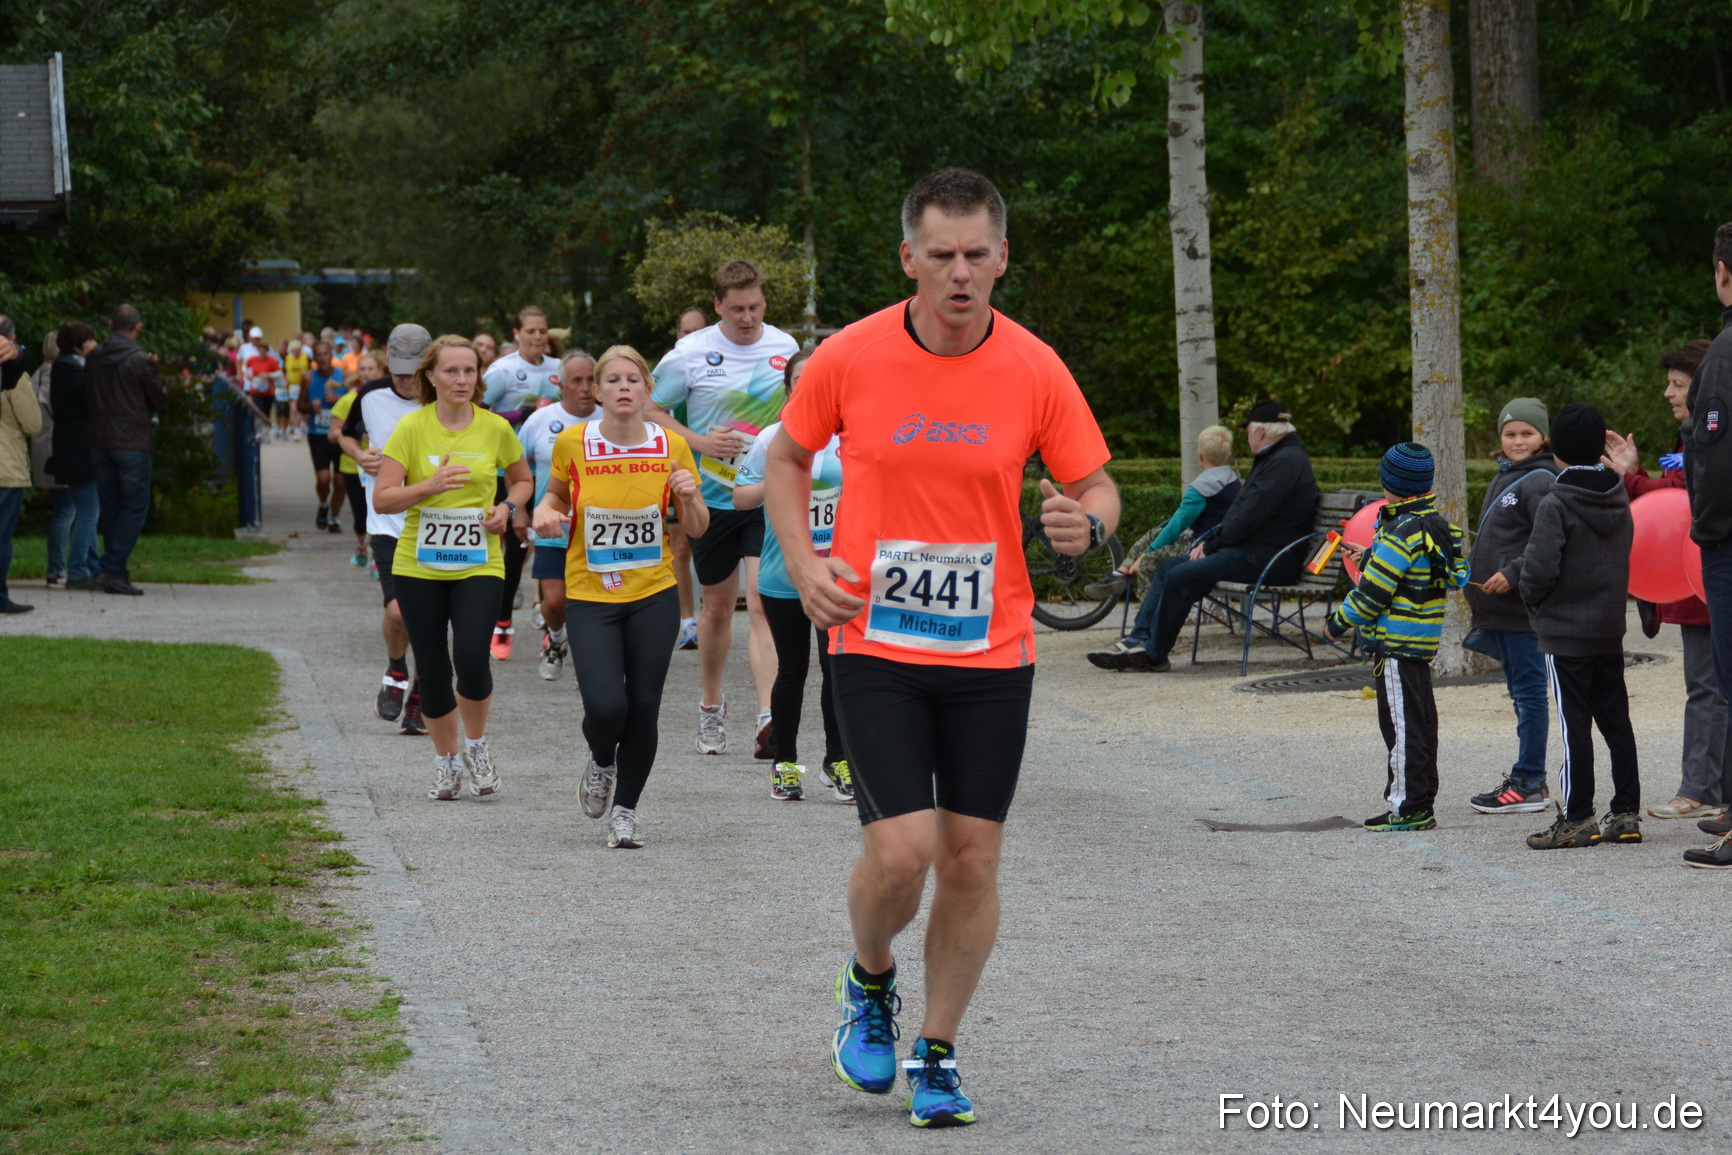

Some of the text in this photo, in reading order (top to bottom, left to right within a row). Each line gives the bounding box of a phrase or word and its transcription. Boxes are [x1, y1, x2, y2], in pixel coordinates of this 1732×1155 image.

[925, 422, 989, 444] asics
[585, 461, 669, 476] MAX BÖGL
[719, 467, 735, 481] Jörg
[421, 512, 441, 520] PARTL
[586, 512, 611, 520] PARTL
[424, 522, 481, 547] 2725
[592, 521, 656, 546] 2738
[812, 531, 831, 542] Anja
[435, 551, 468, 561] Renate
[612, 550, 634, 560] Lisa
[879, 550, 976, 565] PARTL Neumarkt
[884, 566, 980, 610] 2441
[899, 613, 963, 637] Michael
